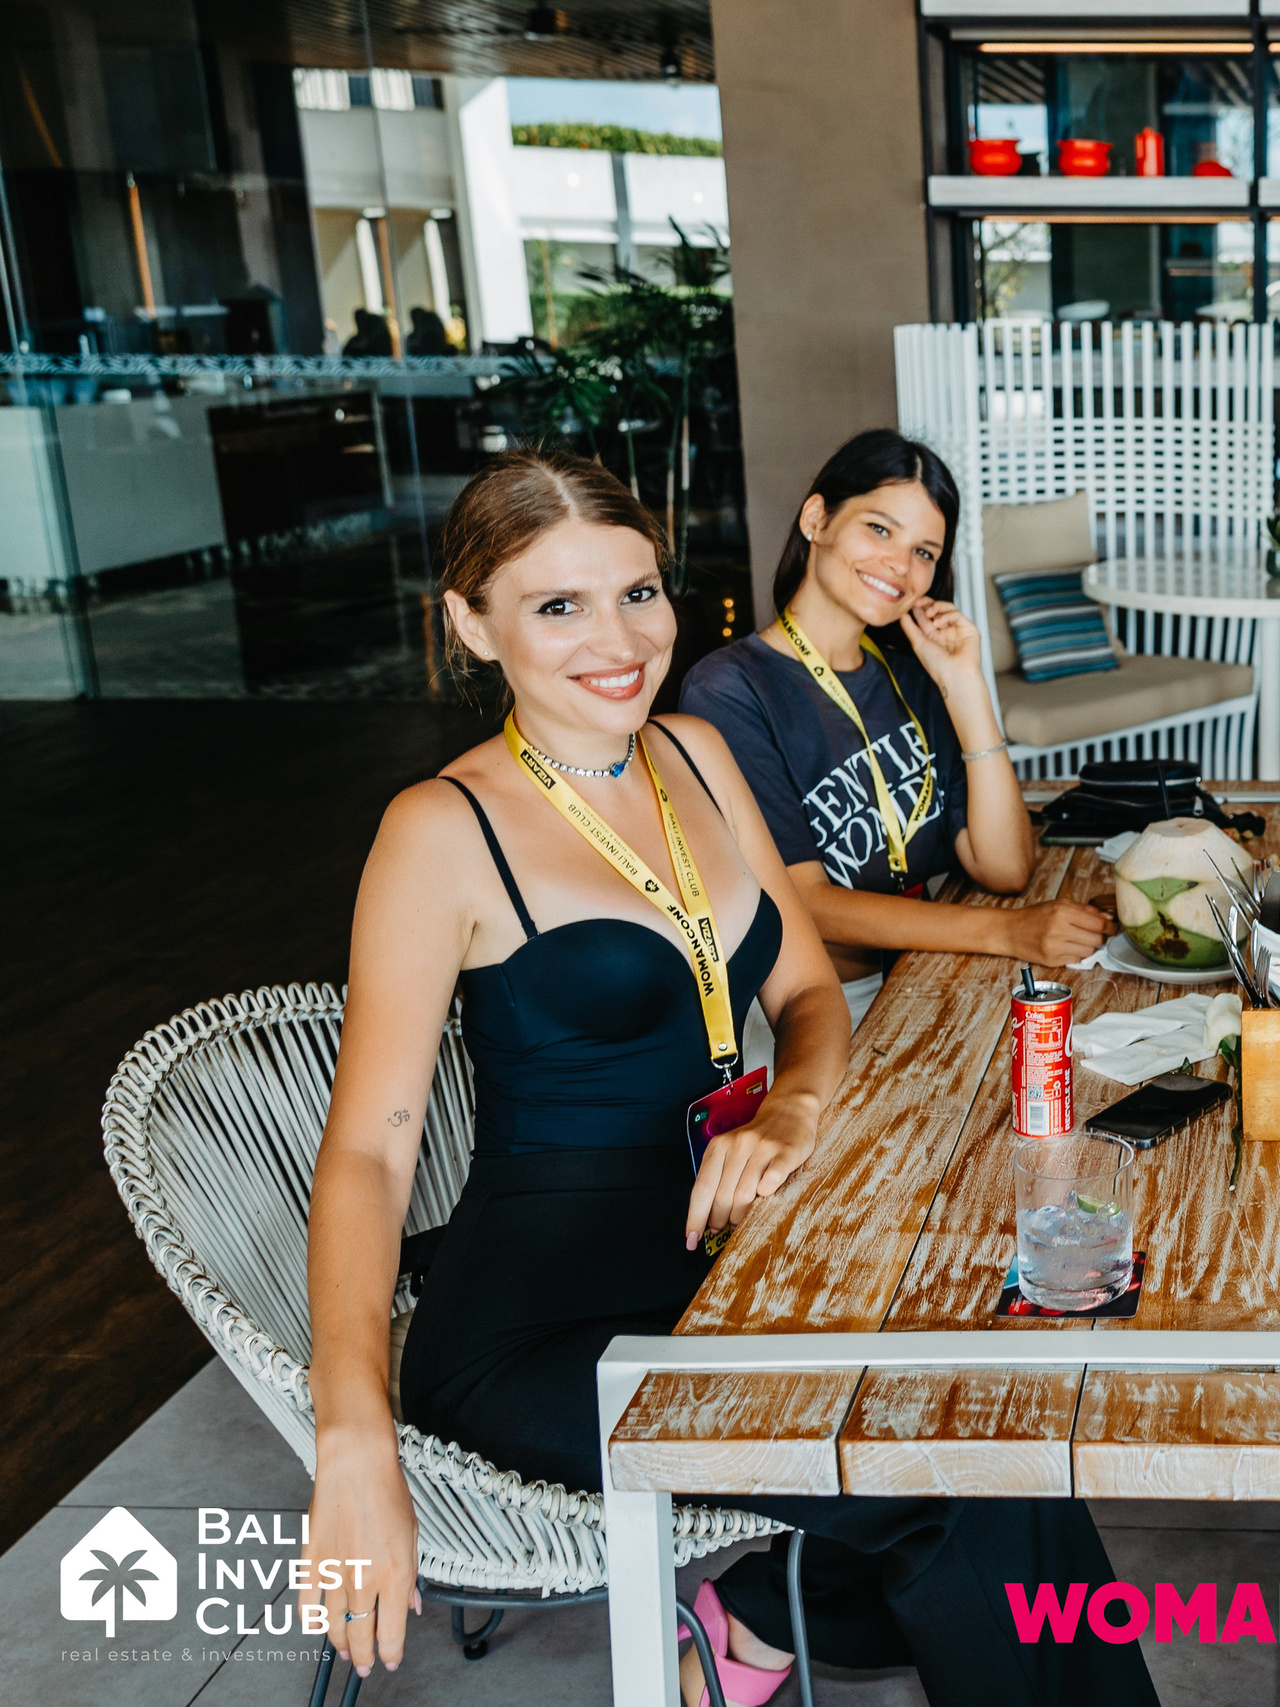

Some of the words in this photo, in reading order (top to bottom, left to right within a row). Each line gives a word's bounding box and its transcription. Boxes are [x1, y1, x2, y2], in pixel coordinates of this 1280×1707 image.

[568, 803, 591, 827] CLUB
[589, 827, 620, 857] INVEST
[619, 855, 638, 876] BALI
[676, 836, 692, 869] INVEST
[686, 872, 700, 897] CLUB
[667, 905, 715, 997] WOMANCONF
